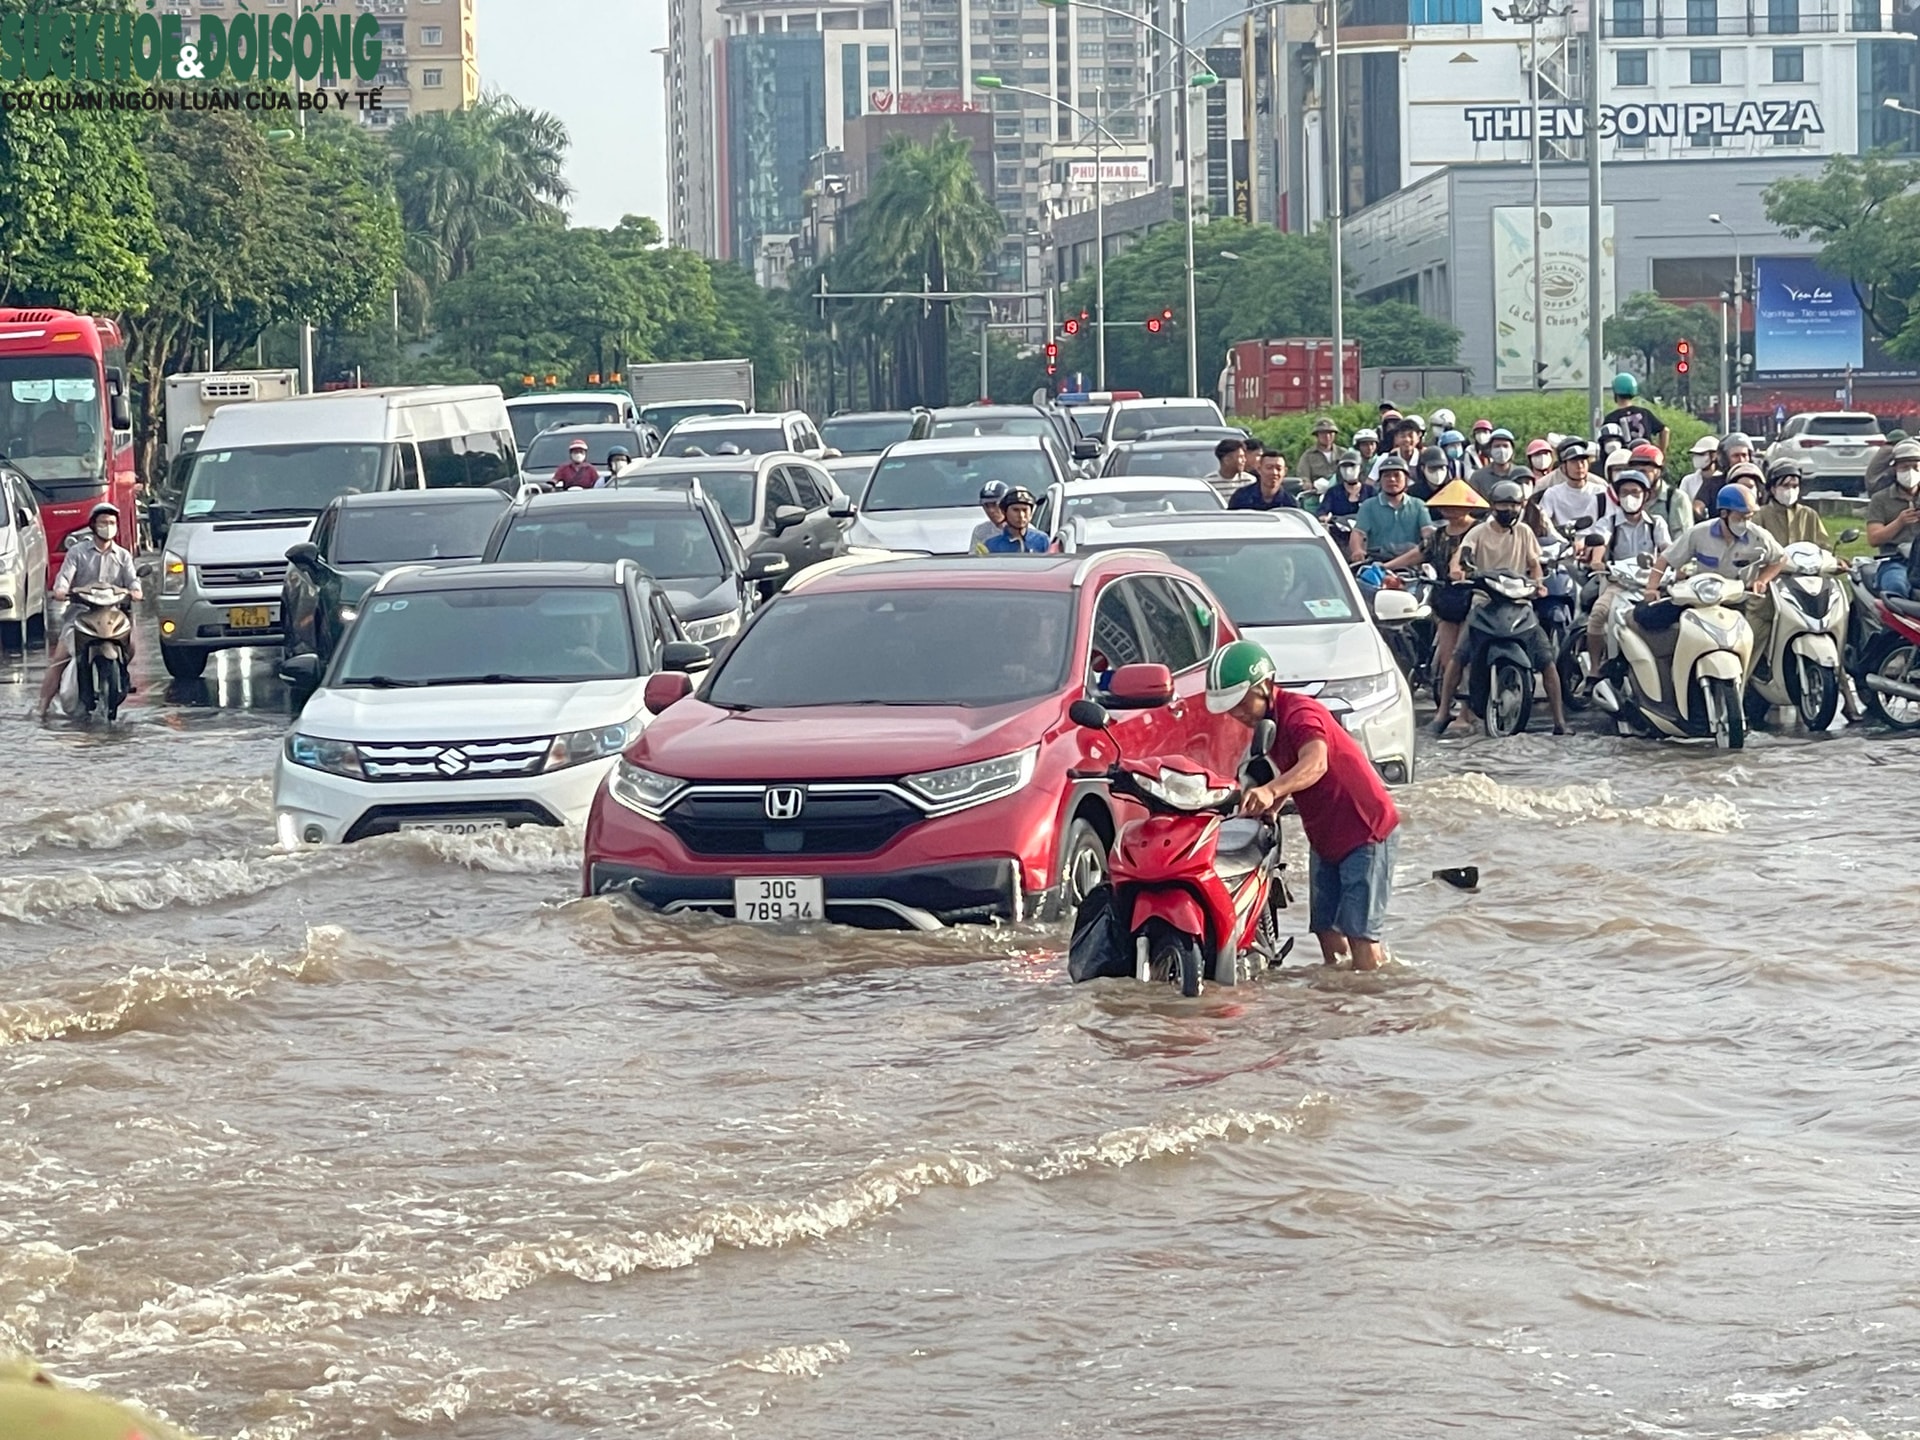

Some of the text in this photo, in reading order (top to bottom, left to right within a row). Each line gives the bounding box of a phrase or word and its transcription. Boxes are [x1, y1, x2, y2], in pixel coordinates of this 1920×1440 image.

[1465, 100, 1825, 141] THIEN SON PLAZA
[760, 881, 796, 899] 30G
